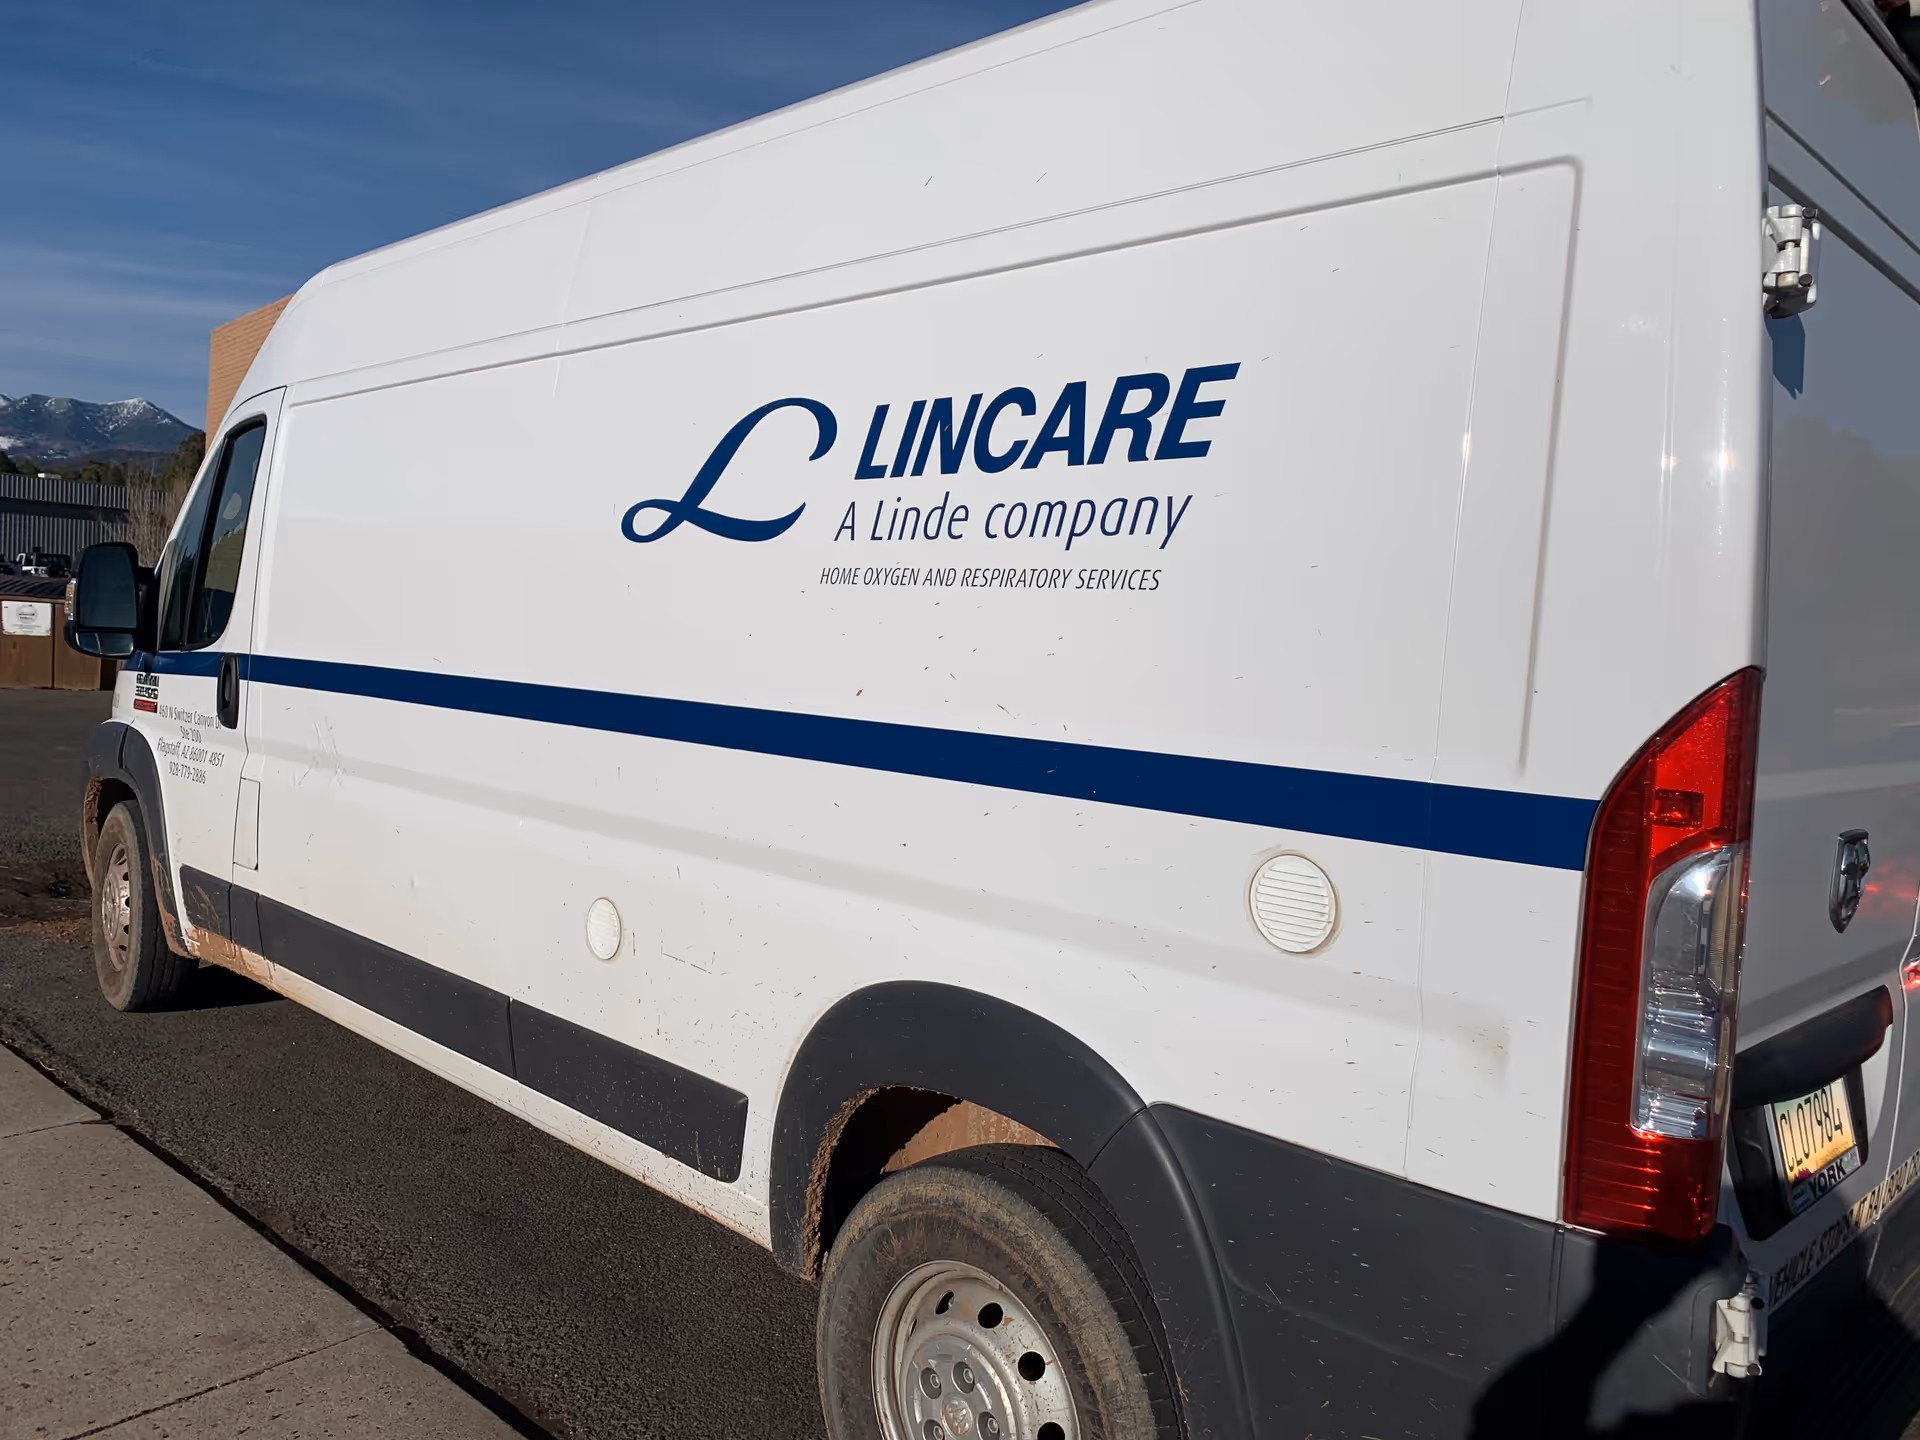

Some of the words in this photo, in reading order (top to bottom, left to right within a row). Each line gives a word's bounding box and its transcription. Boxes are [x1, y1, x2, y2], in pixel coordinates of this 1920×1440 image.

[854, 363, 1241, 481] LINCARE
[833, 501, 856, 542] A
[870, 491, 970, 541] Linde
[984, 494, 1193, 551] company
[819, 567, 861, 585] HOME
[863, 567, 921, 586] OXYGEN
[922, 567, 957, 587] AND
[960, 567, 1073, 589] RESPIRATORY
[1075, 568, 1162, 591] SERVICES
[159, 705, 168, 719] 460
[174, 707, 193, 724] Switzer
[194, 711, 214, 730] Canyon
[157, 737, 181, 759] Flagstaff,
[181, 745, 190, 759] AZ
[189, 746, 208, 763] 86001
[208, 752, 225, 767] 4851
[1808, 1158, 1847, 1199] YORK
